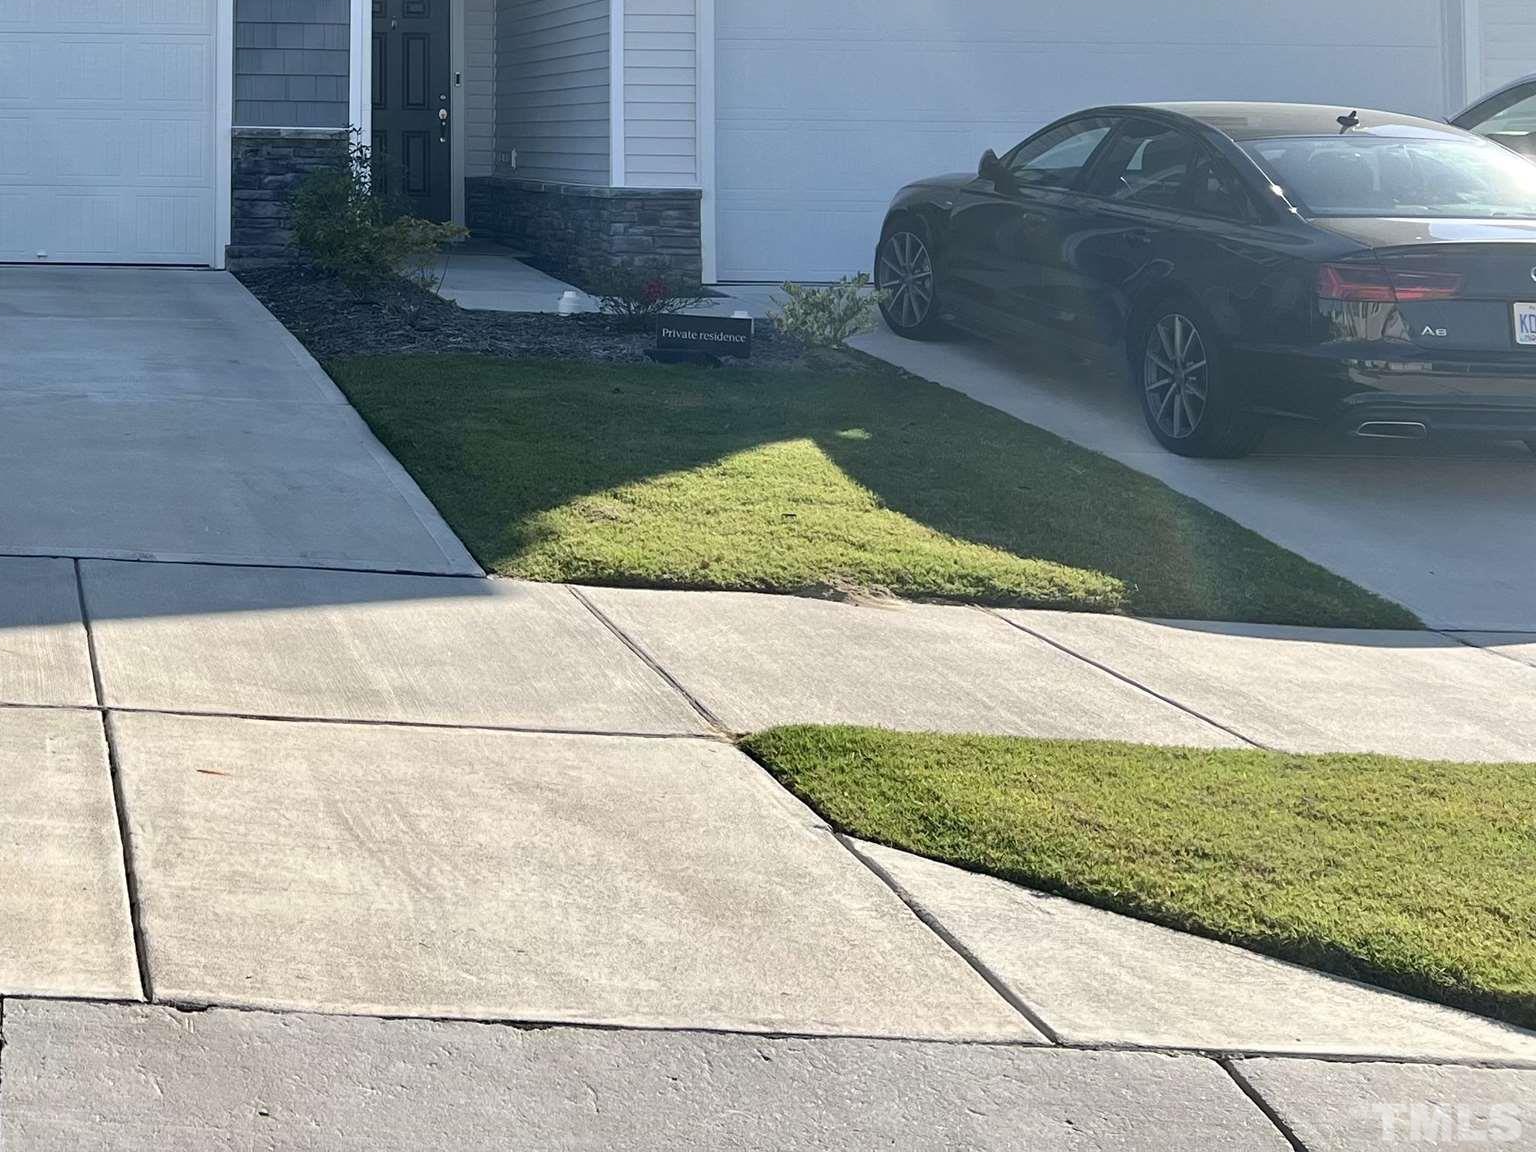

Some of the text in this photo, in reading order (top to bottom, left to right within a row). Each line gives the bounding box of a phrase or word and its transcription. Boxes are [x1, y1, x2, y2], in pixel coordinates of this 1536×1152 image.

[662, 328, 746, 343] Private residence
[1421, 326, 1447, 336] A6
